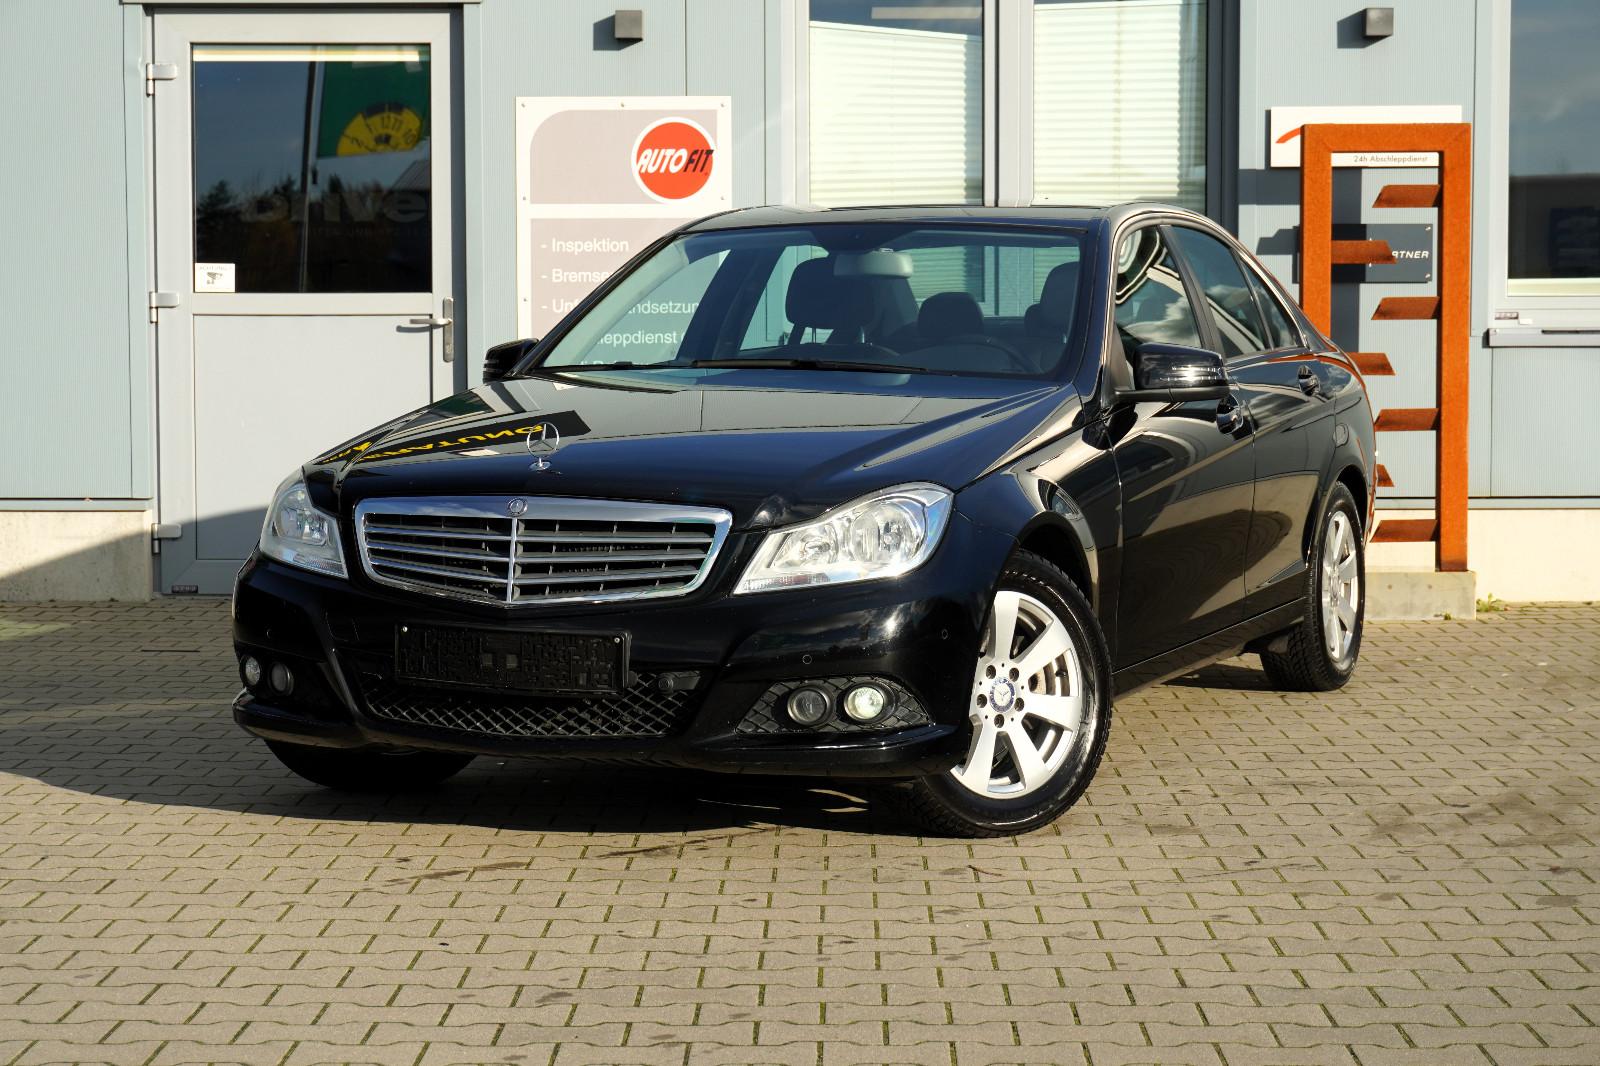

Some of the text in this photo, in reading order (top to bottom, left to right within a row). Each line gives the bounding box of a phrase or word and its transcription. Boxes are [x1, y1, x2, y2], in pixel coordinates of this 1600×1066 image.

[637, 148, 714, 174] AUTOFIT
[1353, 154, 1428, 164] 24h Abschleppdienst
[552, 238, 629, 254] Inspektion
